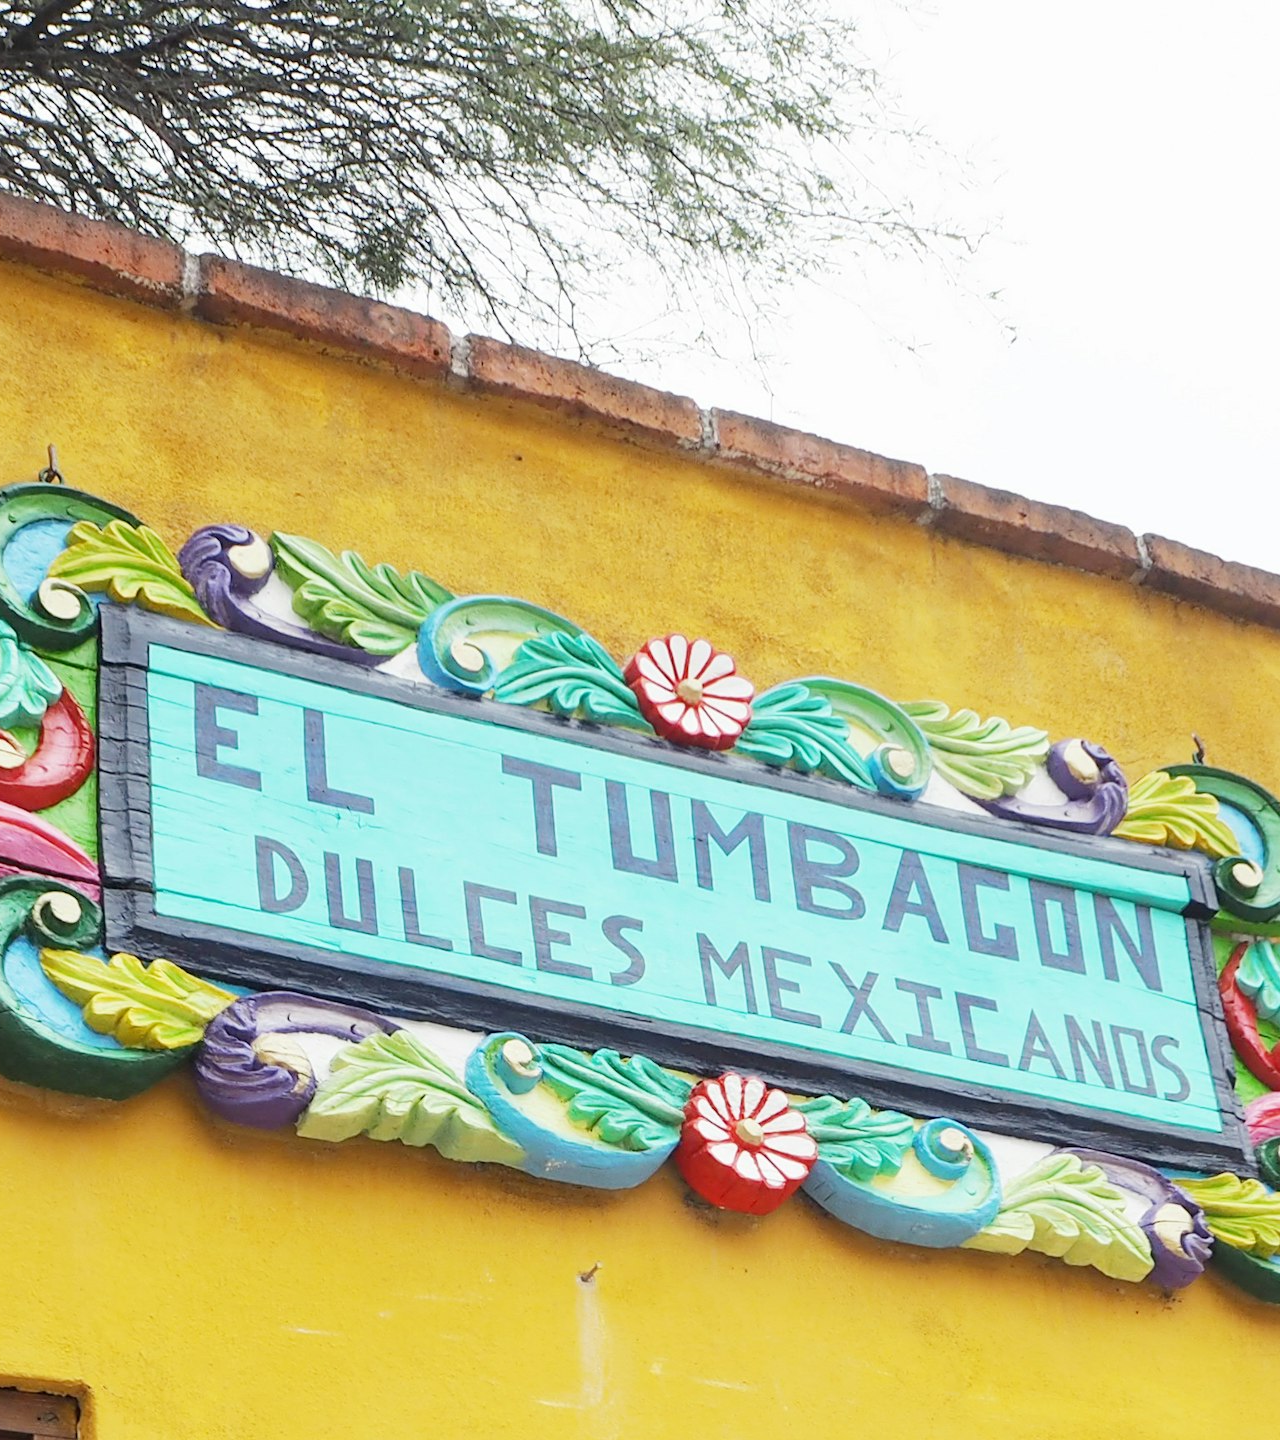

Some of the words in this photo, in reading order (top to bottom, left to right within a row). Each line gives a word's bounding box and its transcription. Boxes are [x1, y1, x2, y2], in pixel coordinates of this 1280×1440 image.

[194, 683, 374, 815] EL
[502, 755, 1162, 991] TUMBAGON
[254, 836, 644, 986] DULCES
[696, 932, 1191, 1101] MEXICANOS
